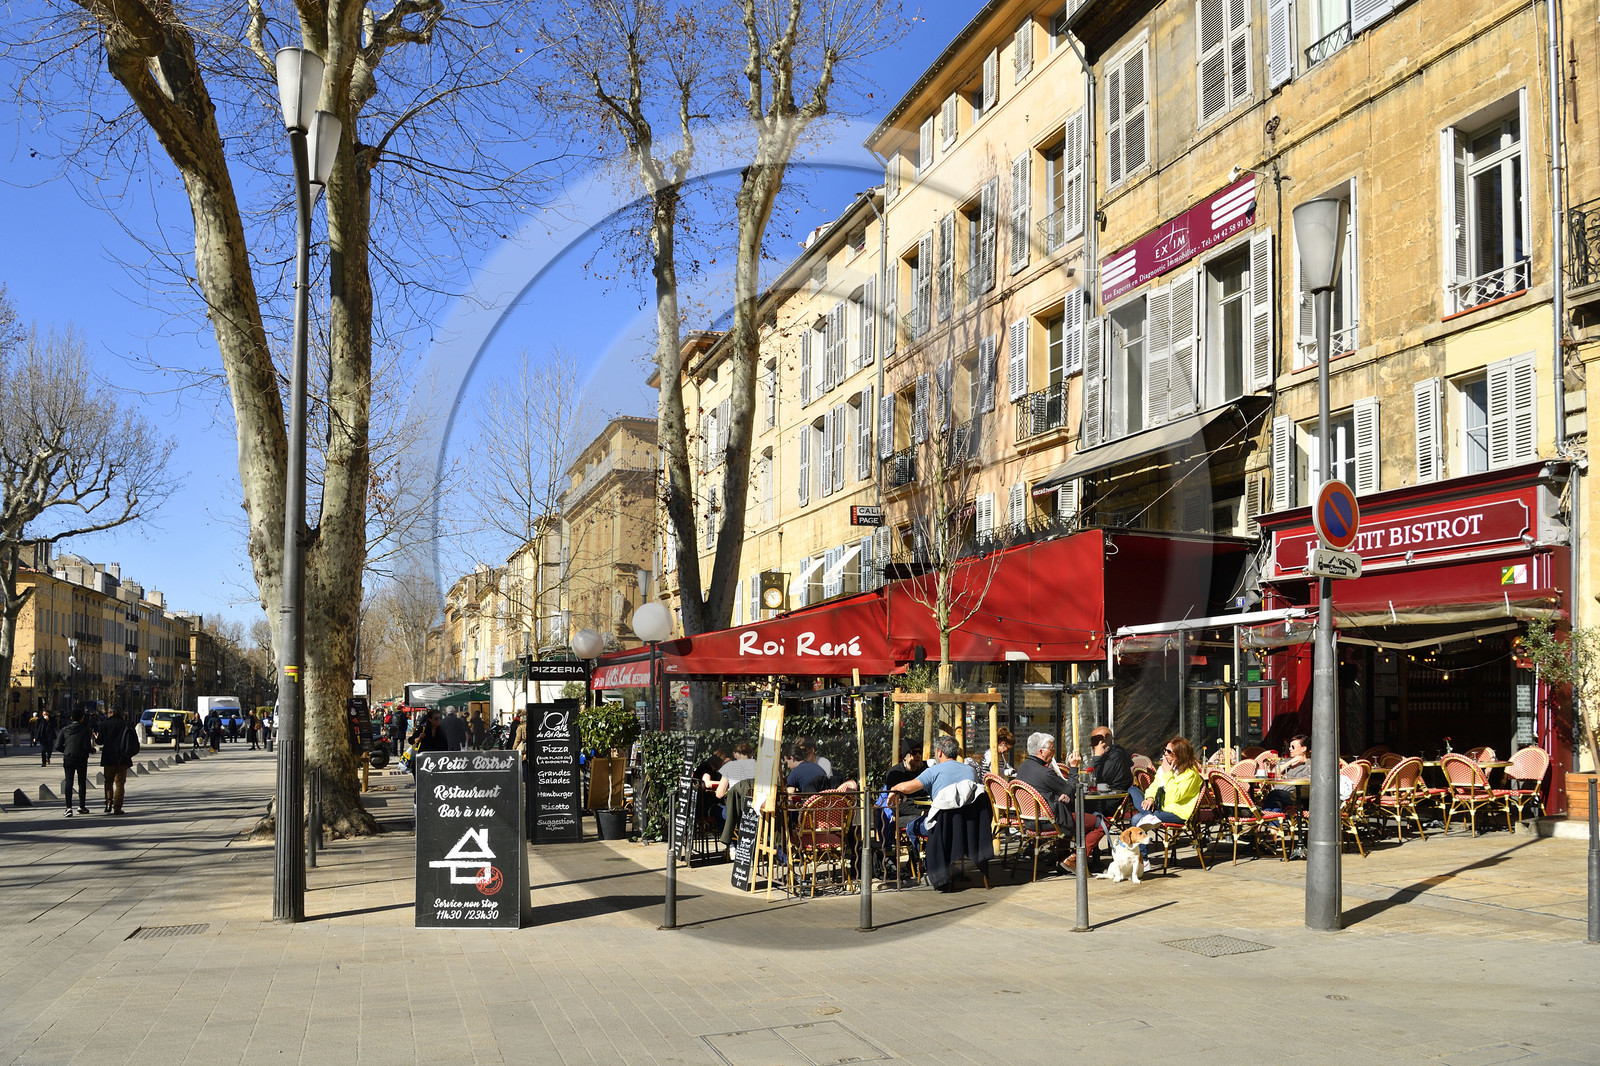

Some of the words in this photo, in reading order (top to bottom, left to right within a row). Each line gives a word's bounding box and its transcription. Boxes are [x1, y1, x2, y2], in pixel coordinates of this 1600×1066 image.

[1113, 283, 1131, 296] Experts
[1139, 263, 1166, 282] Diagnostic
[1166, 246, 1197, 267] Immobilier
[1213, 232, 1220, 242] 04
[1221, 228, 1228, 237] 42
[1229, 223, 1236, 234] 58
[858, 507, 879, 515] CALI
[1389, 514, 1484, 547] BISTROT
[739, 631, 785, 656] Roi
[797, 631, 862, 656] René
[420, 757, 436, 772] Le
[437, 756, 469, 770] Petit
[472, 755, 515, 770] Bistrot
[537, 769, 571, 778] Grandes
[538, 777, 571, 785] Salades
[433, 784, 502, 800] Restaurant
[537, 791, 574, 799] Hamburger
[438, 804, 462, 818] Bar
[463, 806, 473, 817] à
[474, 805, 496, 817] vin
[537, 818, 575, 827] Suggestion
[433, 898, 462, 908] Service
[481, 898, 499, 910] stop
[436, 910, 462, 920] 11h30
